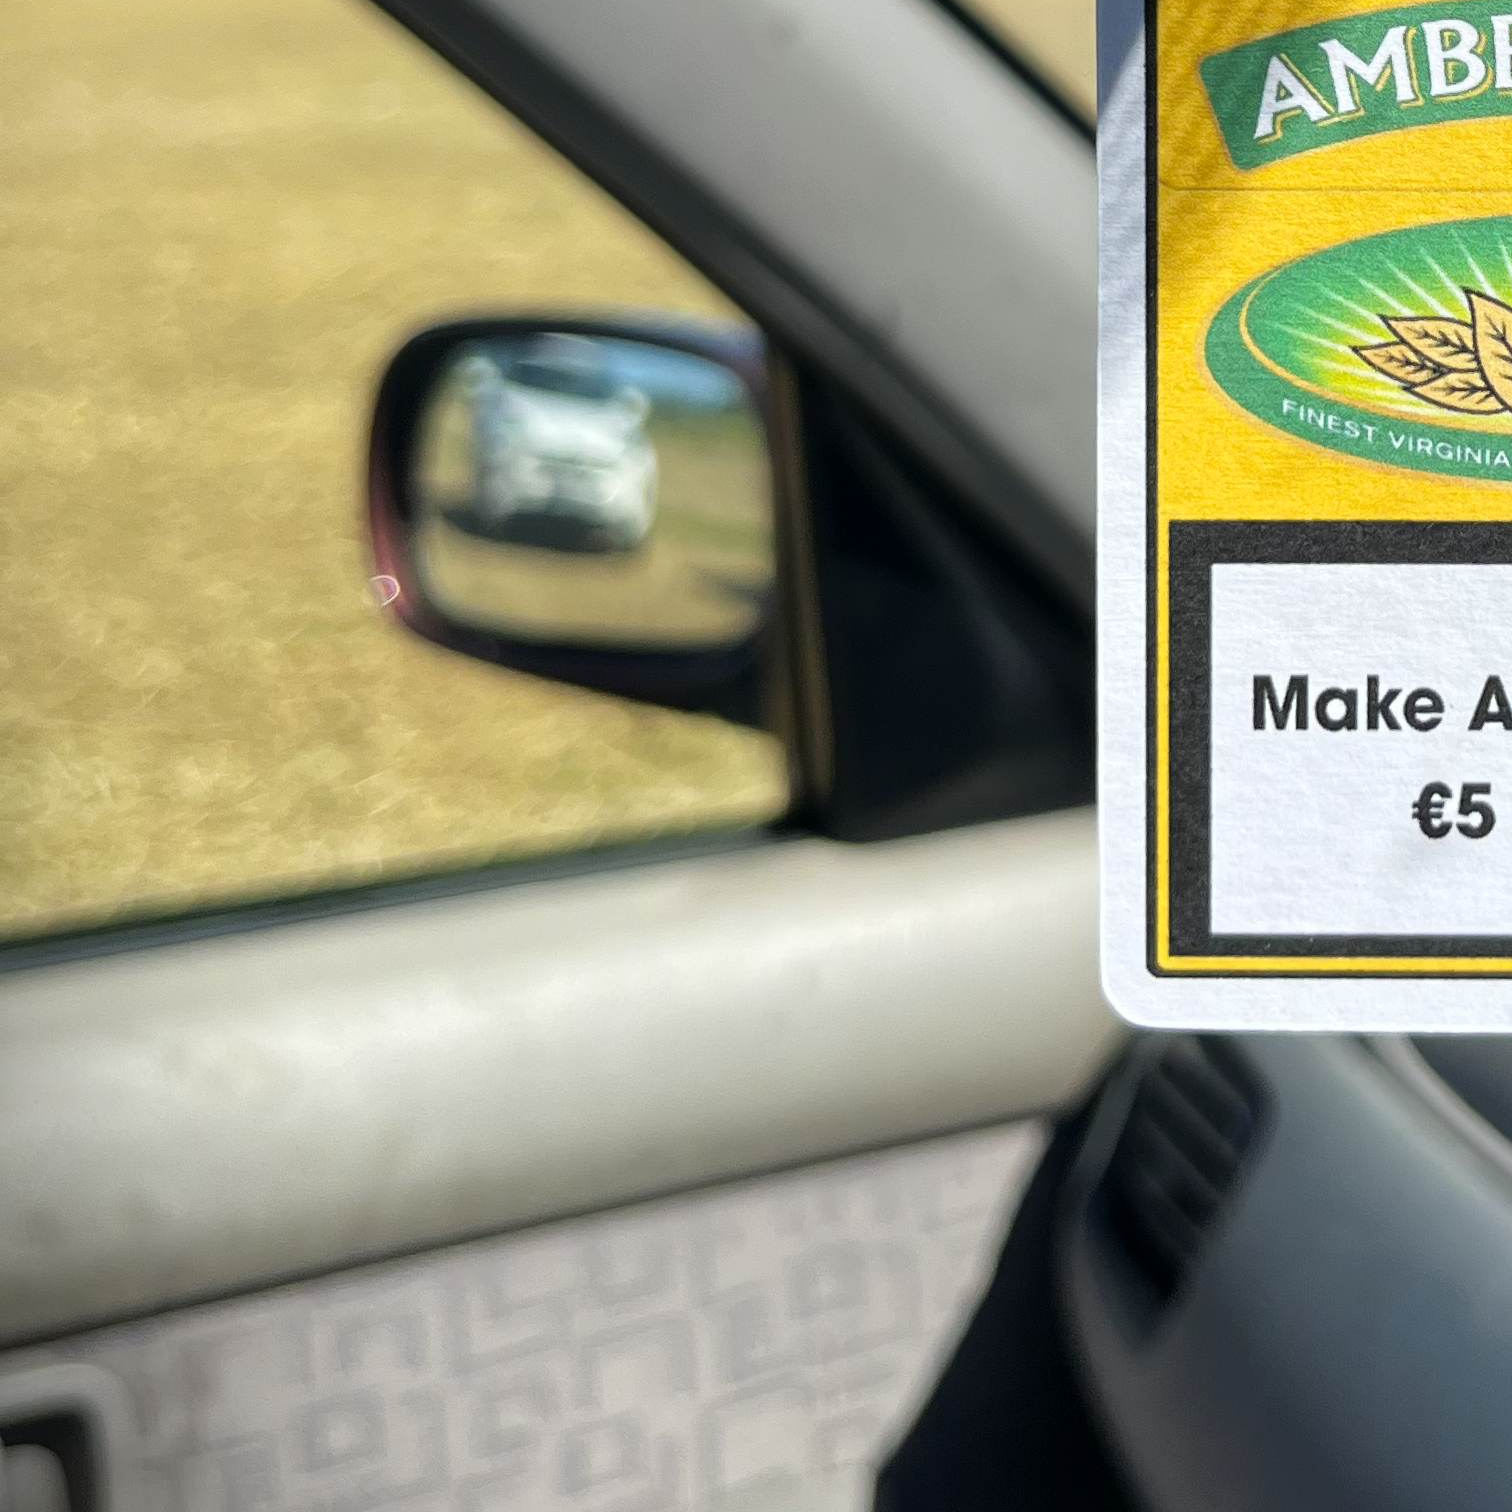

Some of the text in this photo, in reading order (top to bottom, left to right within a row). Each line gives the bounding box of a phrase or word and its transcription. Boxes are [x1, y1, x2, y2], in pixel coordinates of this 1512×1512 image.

[1281, 398, 1377, 442] FINEST
[1388, 430, 1510, 468] VIRGINIA
[1252, 674, 1444, 732] Make
[1412, 781, 1496, 839] €5
